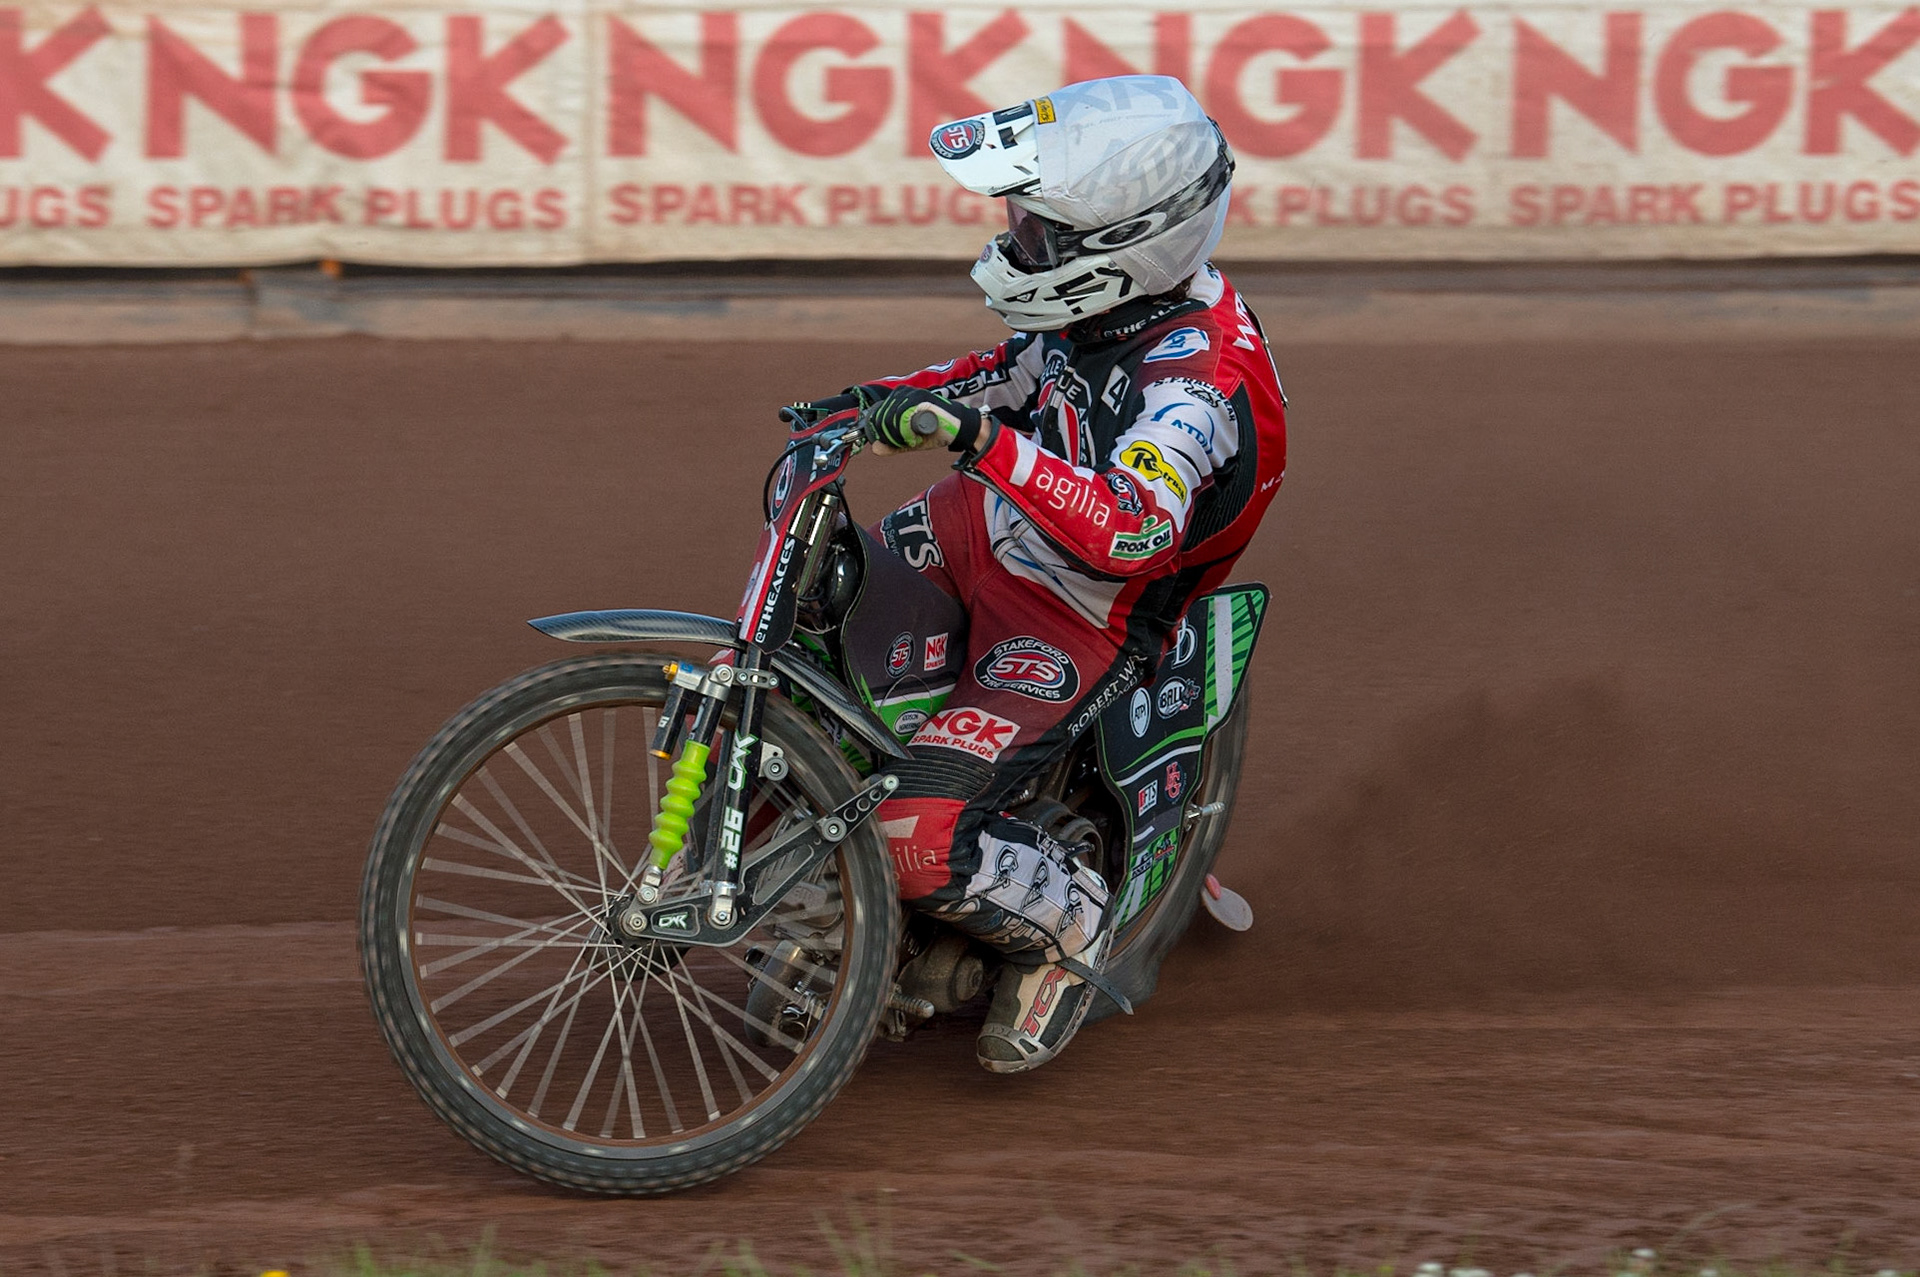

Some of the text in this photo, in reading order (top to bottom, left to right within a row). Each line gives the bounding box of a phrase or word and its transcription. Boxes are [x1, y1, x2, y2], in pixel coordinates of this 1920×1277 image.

[143, 13, 571, 164] NGK
[606, 9, 1032, 160] NGK
[1510, 8, 1920, 162] NGK
[146, 185, 569, 231] SPARK PLUGS
[608, 182, 811, 227] SPARK
[1276, 183, 1476, 228] PLUGS
[1508, 180, 1920, 227] SPARK PLUGS
[1035, 466, 1111, 528] agilia
[896, 500, 940, 568] FTS
[1152, 529, 1171, 547] OIL
[926, 634, 947, 660] NGK
[989, 656, 1062, 682] STS
[993, 638, 1070, 665] STAKEFORD
[918, 710, 1014, 750] NGK
[1067, 681, 1119, 739] ROBERT
[910, 734, 995, 760] SPARK PLUGS
